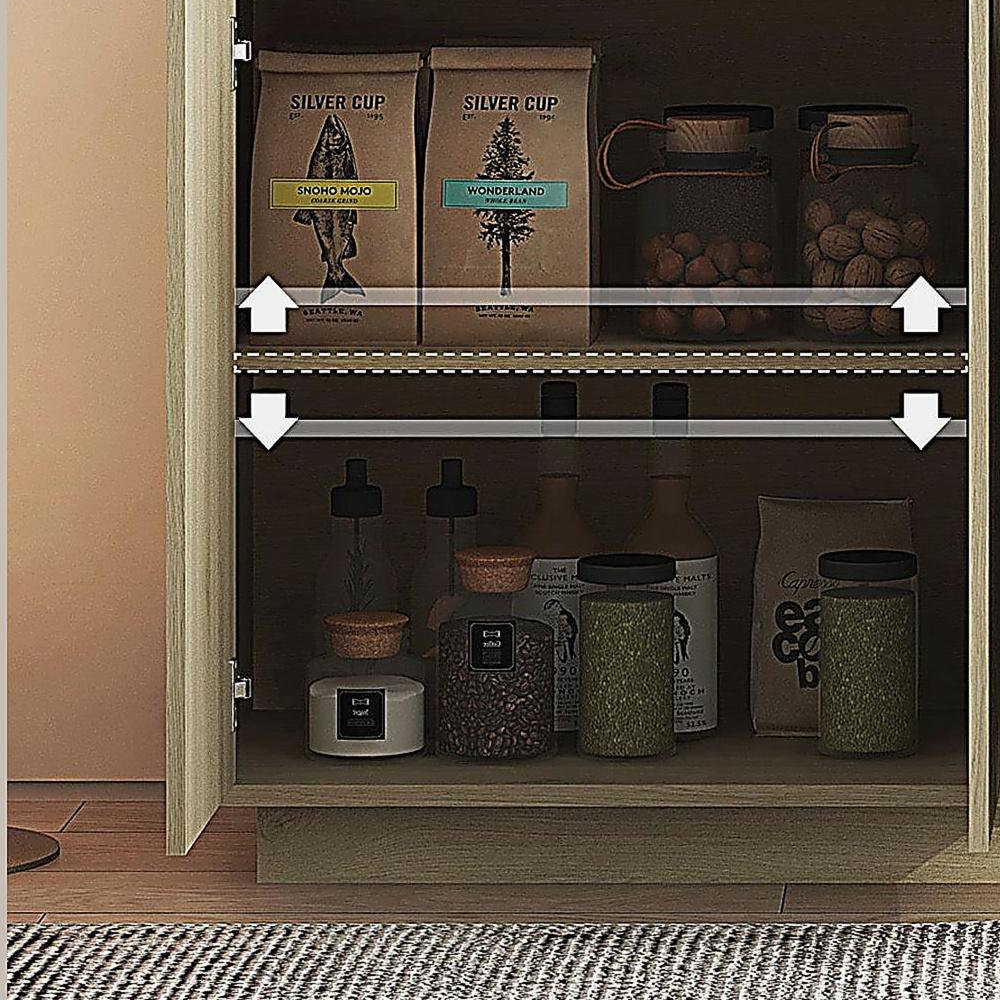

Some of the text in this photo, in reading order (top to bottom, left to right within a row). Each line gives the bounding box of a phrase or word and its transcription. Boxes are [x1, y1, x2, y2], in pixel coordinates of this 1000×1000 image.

[289, 94, 386, 110] SILVER CUP
[463, 95, 559, 112] SILVER CUP
[297, 186, 372, 196] SNOHO MOJO
[467, 186, 545, 196] WONDERLAND
